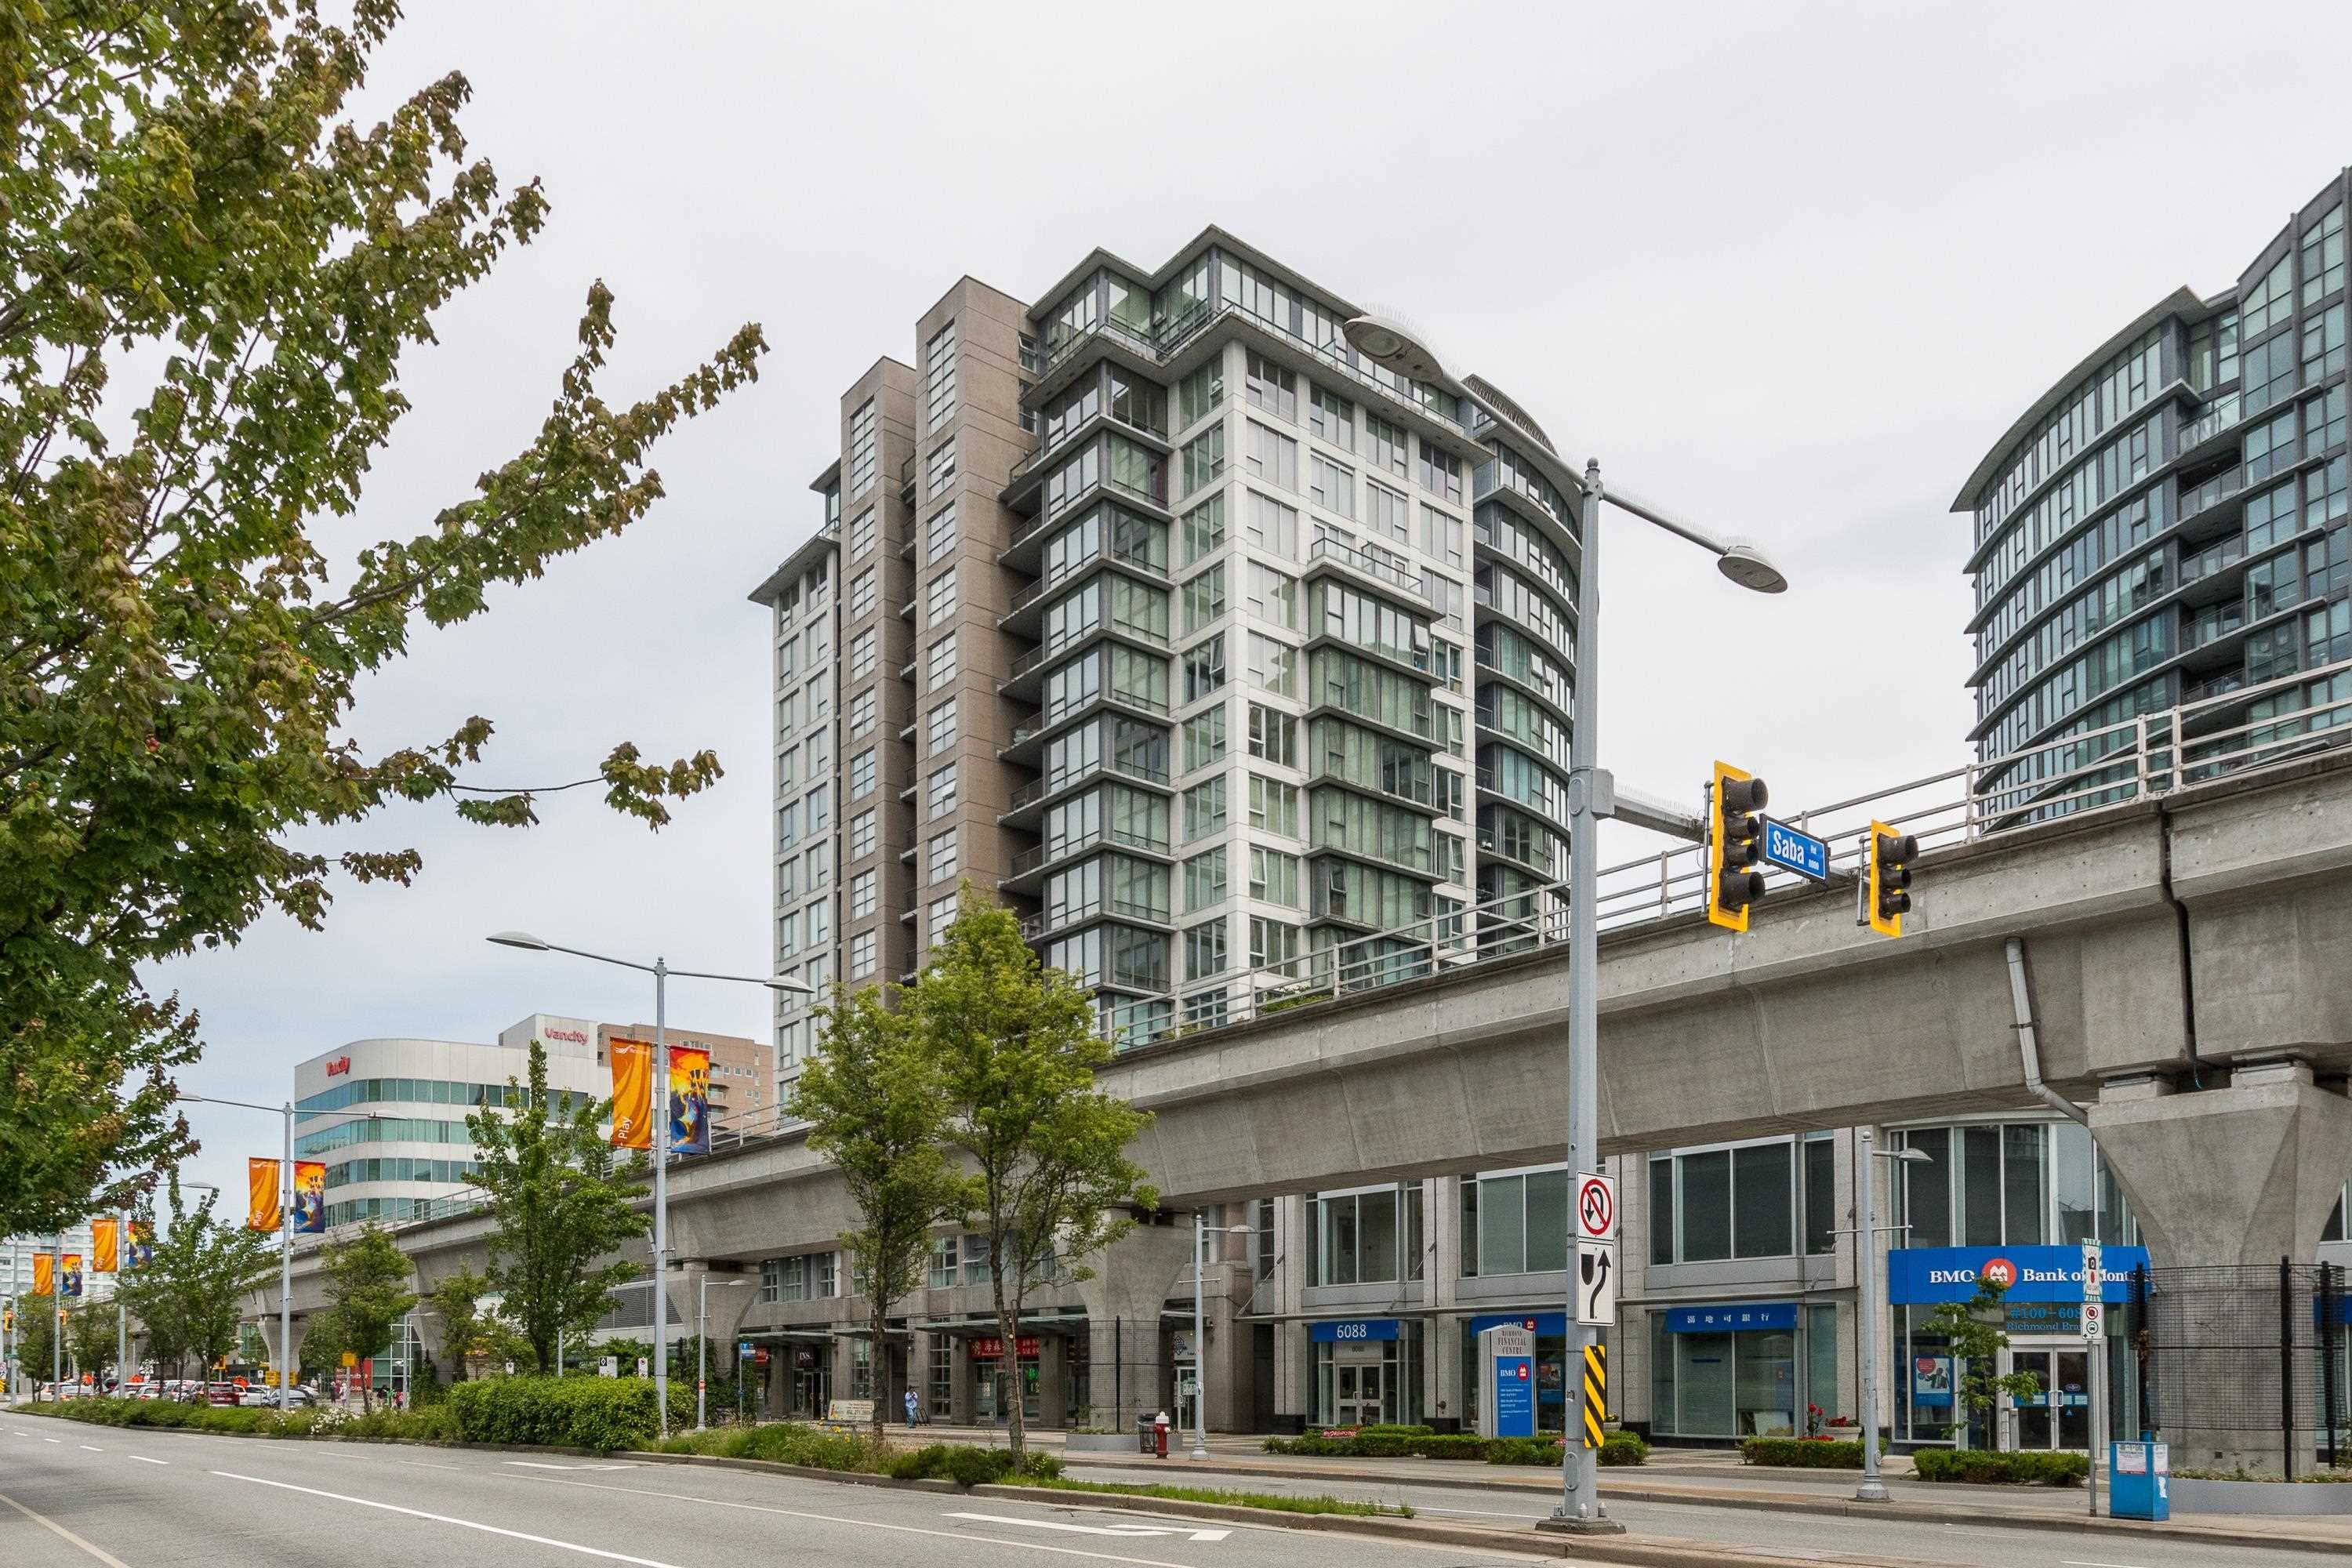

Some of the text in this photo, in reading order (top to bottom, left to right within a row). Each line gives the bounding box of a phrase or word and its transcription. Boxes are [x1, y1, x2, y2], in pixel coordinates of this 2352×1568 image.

[1773, 829, 1804, 865] Saba
[545, 1027, 589, 1046] Vancity
[618, 1116, 633, 1140] Play
[1929, 1269, 1975, 1283] BMO
[2023, 1269, 2068, 1282] Bank
[1337, 1323, 1367, 1338] 6088
[1498, 1338, 1526, 1346] FINANCIAL
